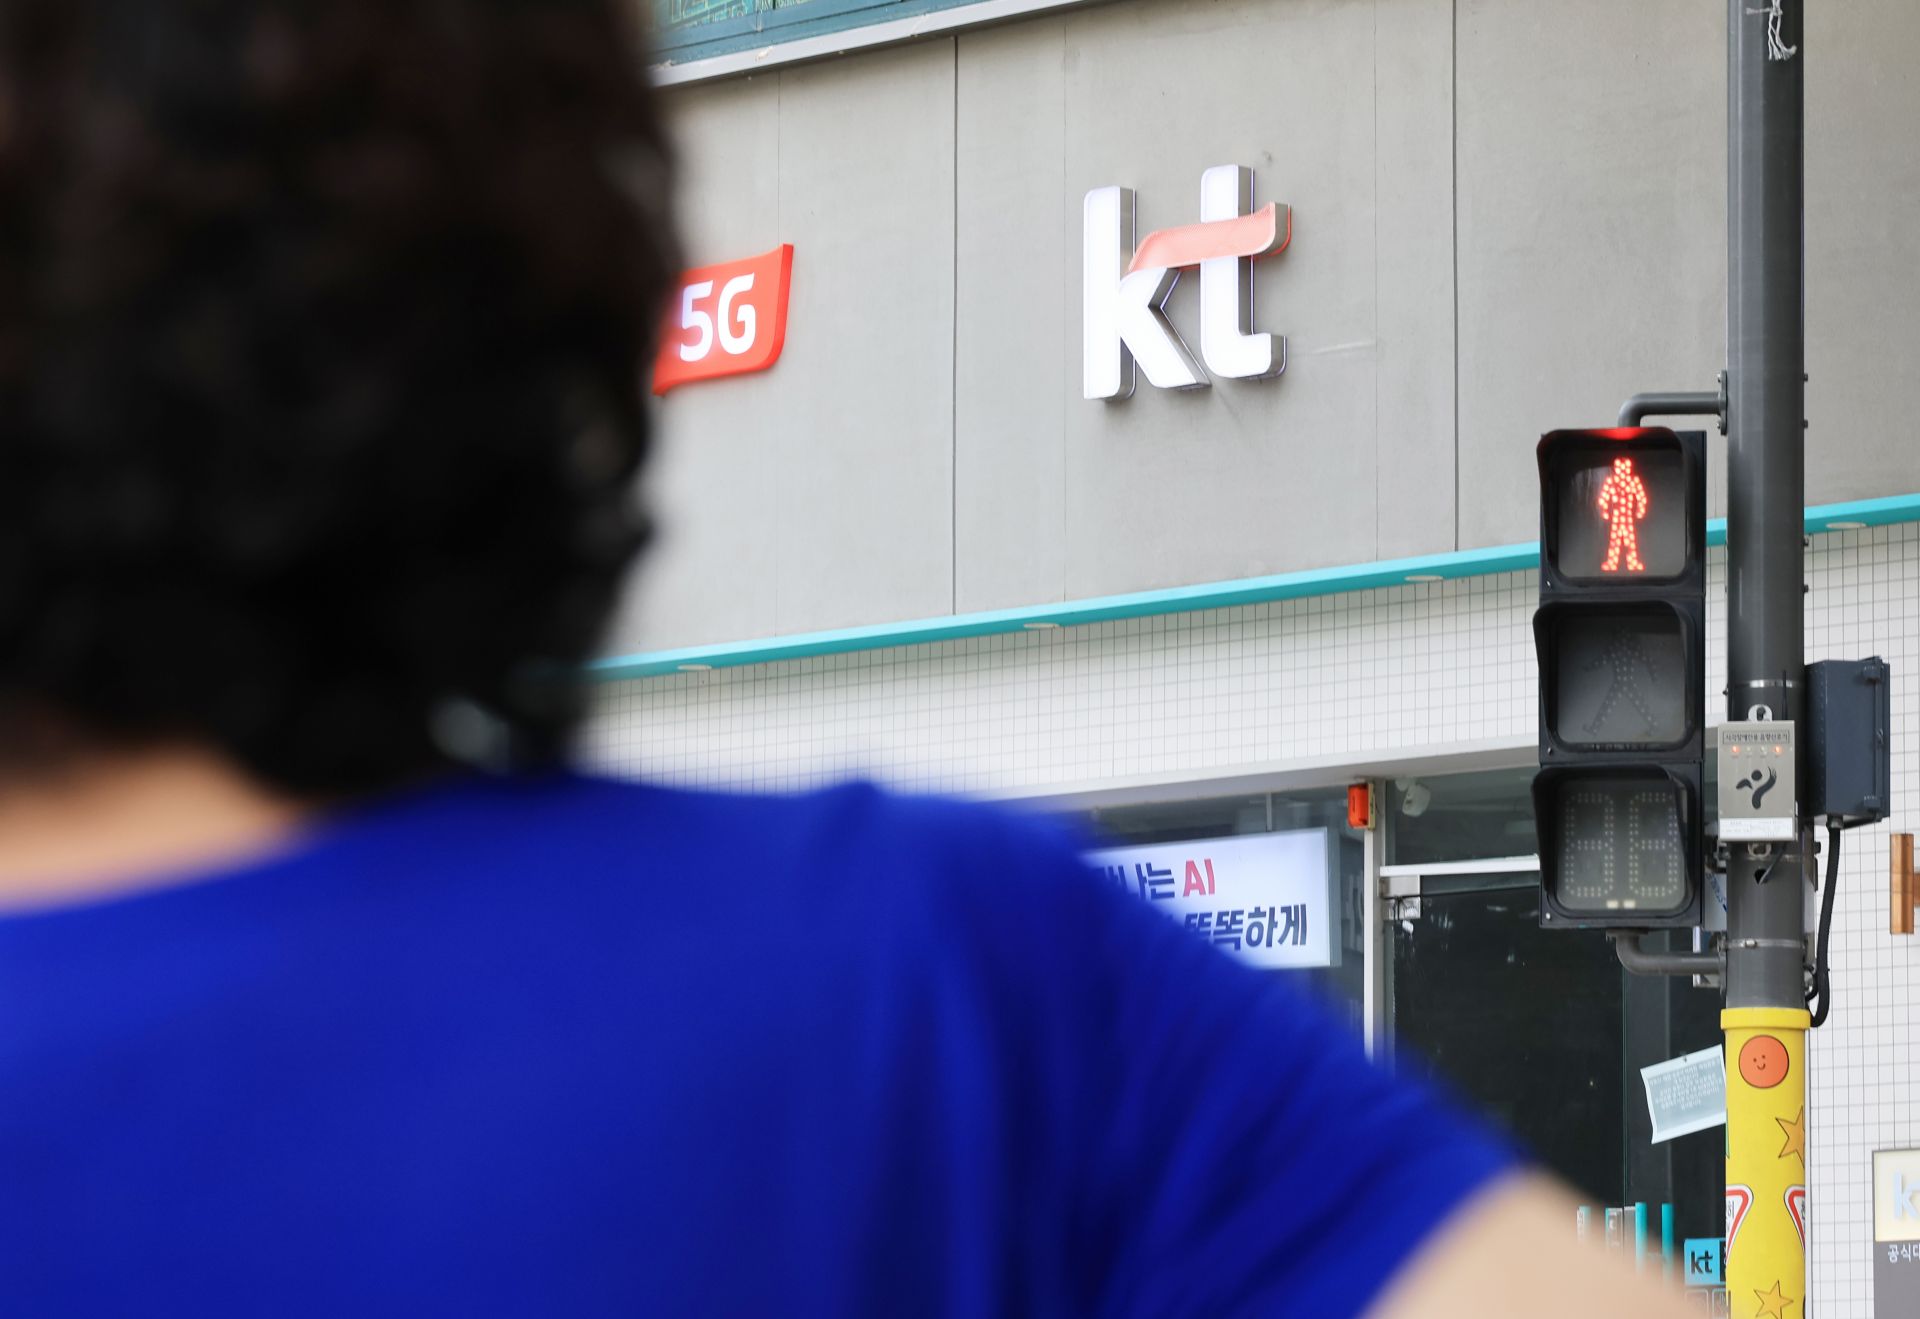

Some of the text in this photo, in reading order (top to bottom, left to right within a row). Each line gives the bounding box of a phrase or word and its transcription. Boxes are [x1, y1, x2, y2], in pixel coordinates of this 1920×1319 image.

[1083, 164, 1290, 401] kt
[678, 272, 757, 363] 5G
[1102, 858, 1216, 900] 나는 AI
[1892, 1168, 1920, 1220] k
[1690, 1250, 1714, 1275] kt
